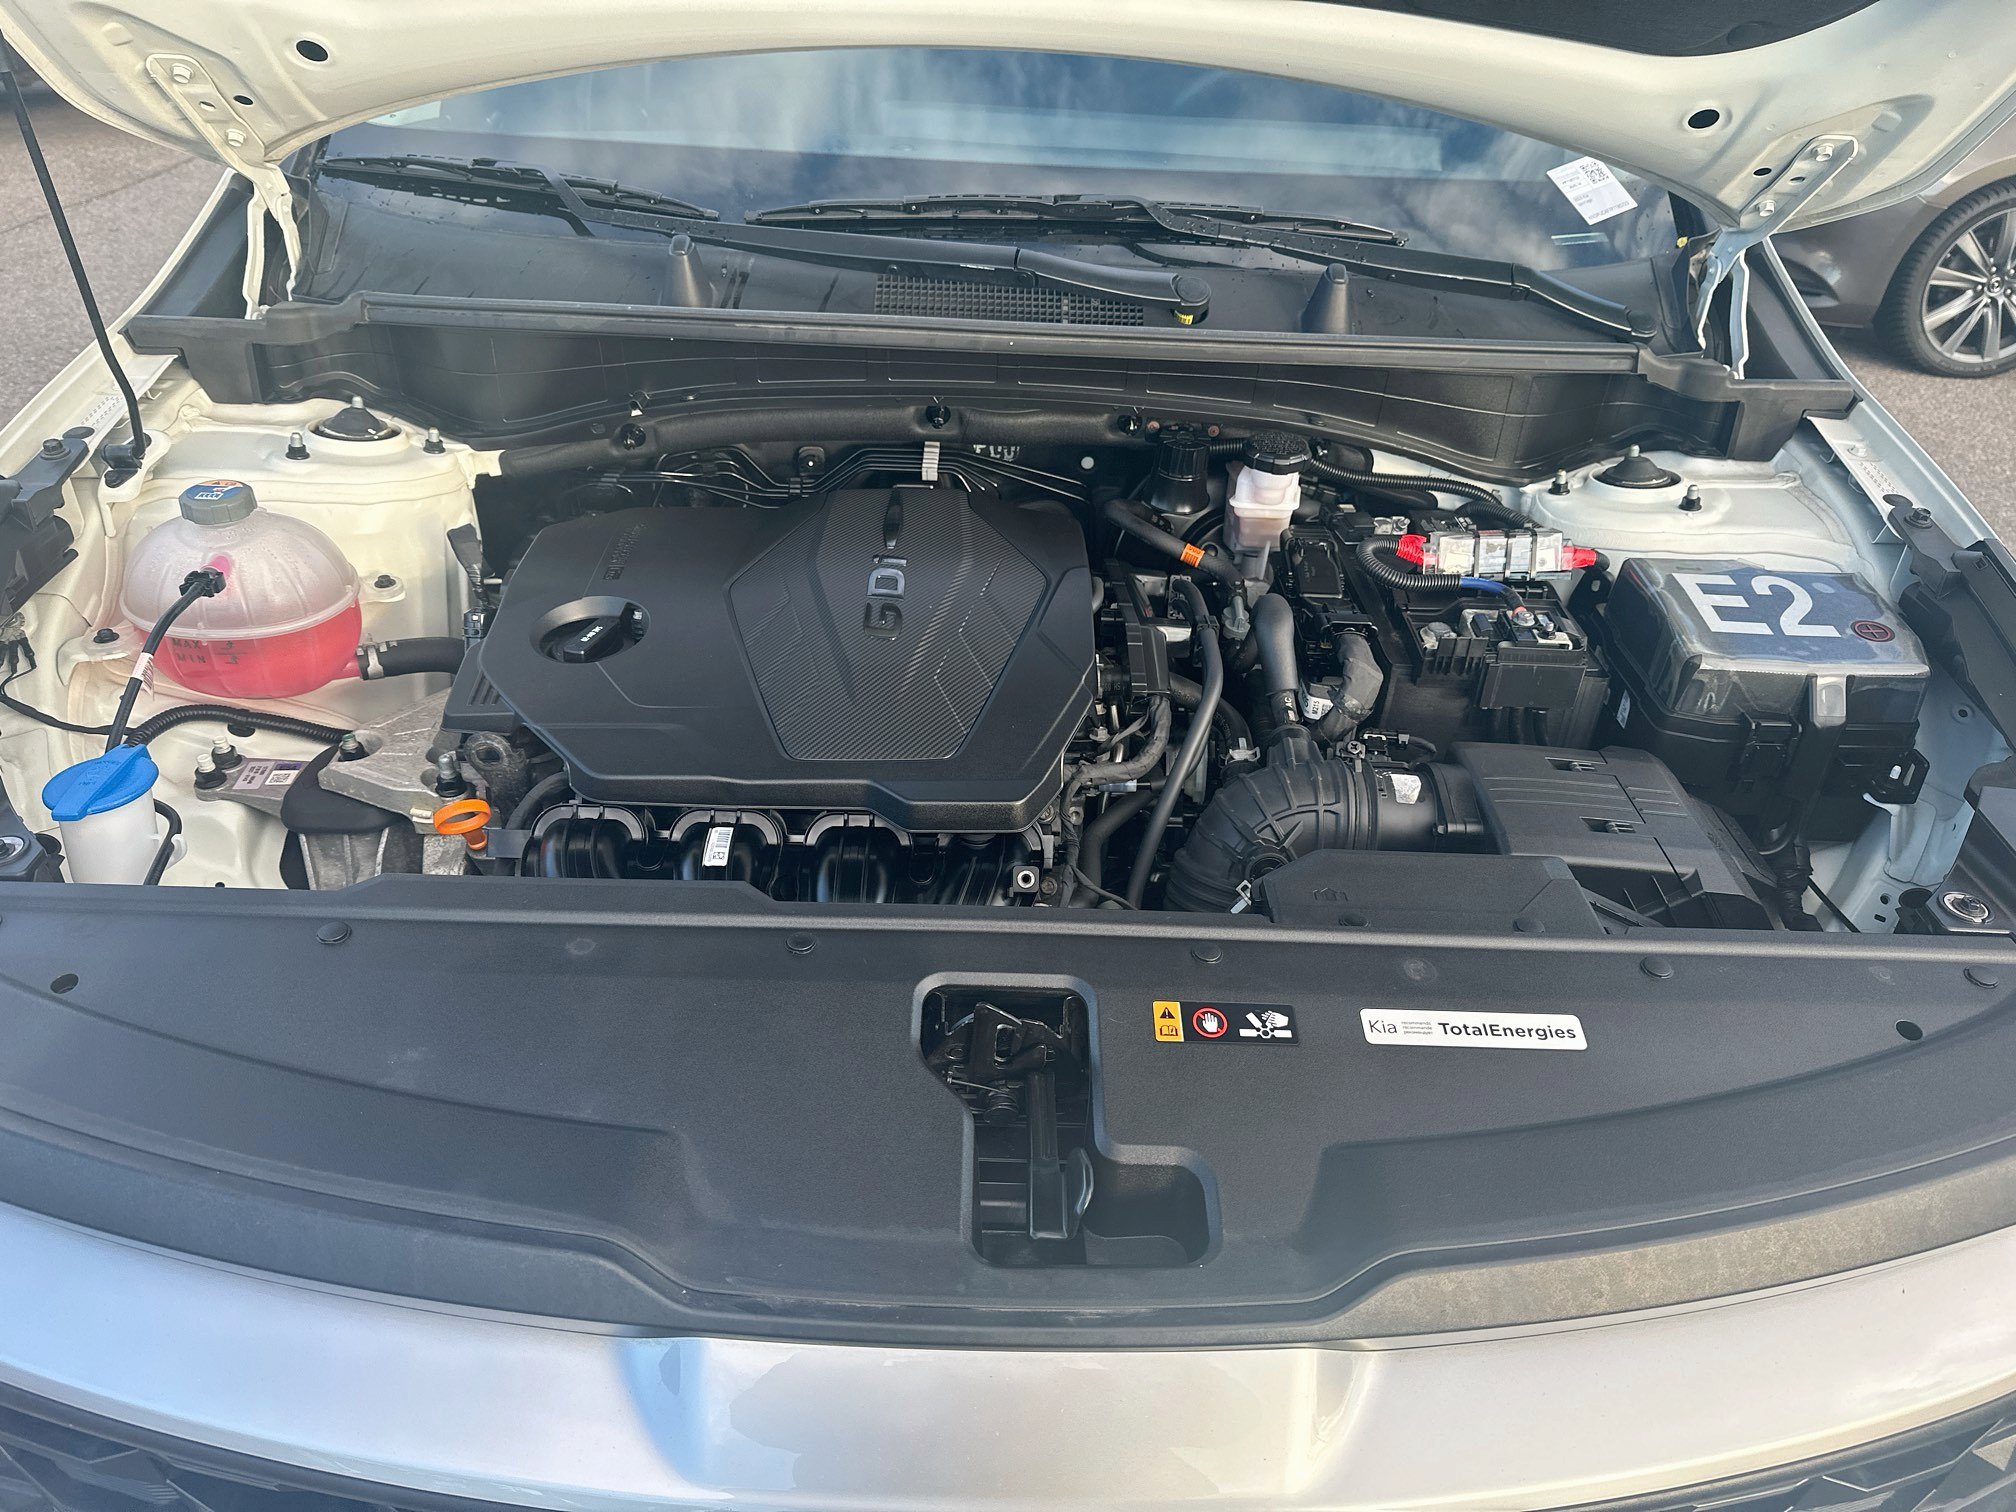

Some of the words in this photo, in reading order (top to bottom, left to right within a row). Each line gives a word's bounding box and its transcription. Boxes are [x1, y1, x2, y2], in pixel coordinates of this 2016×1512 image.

[1671, 572, 1842, 638] E2
[172, 639, 200, 650] MAX
[177, 653, 206, 664] MIN
[1284, 696, 1293, 708] AC
[1368, 1018, 1398, 1034] Kia
[1437, 1021, 1577, 1041] TotalEnergies
